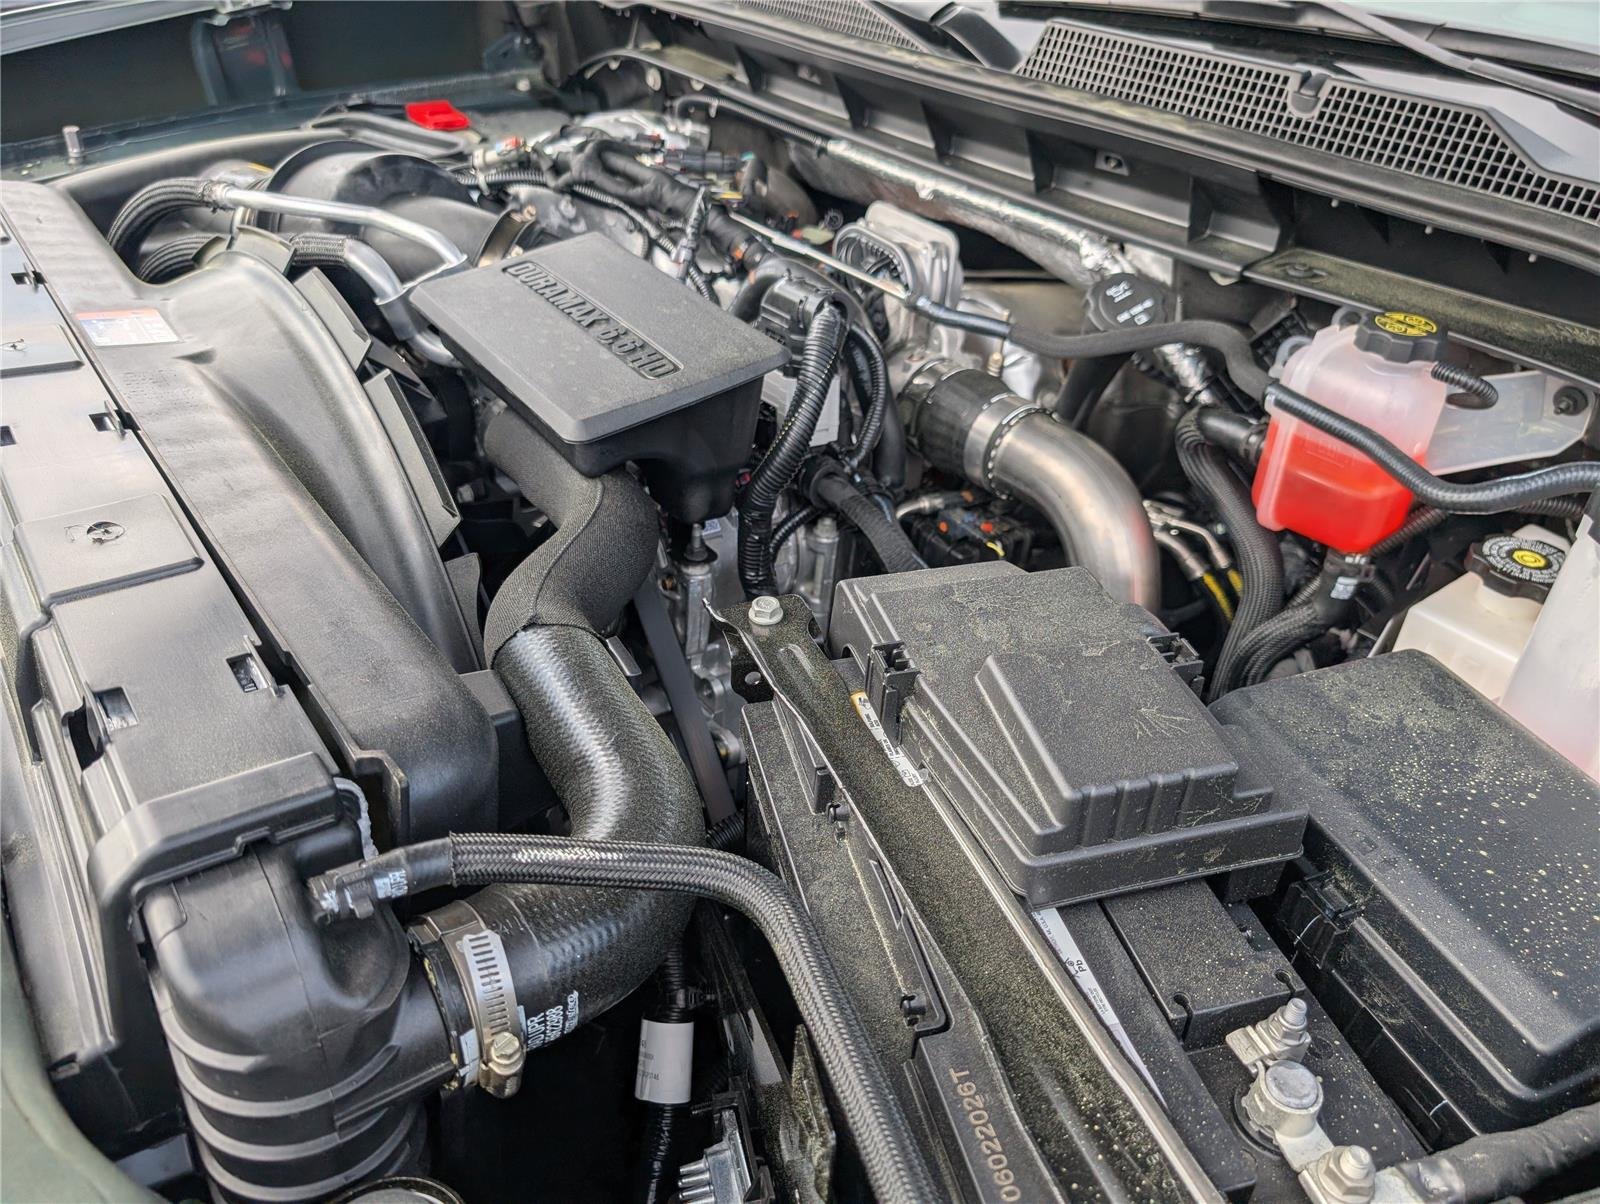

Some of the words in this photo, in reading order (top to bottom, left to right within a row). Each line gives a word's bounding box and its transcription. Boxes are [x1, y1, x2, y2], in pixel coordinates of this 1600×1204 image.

[506, 262, 609, 328] DURAMAX
[598, 325, 645, 355] 6.6
[629, 350, 677, 379] HD
[1076, 959, 1087, 973] Pb
[527, 1012, 545, 1038] UPR
[949, 1067, 1021, 1202] 06022026T
